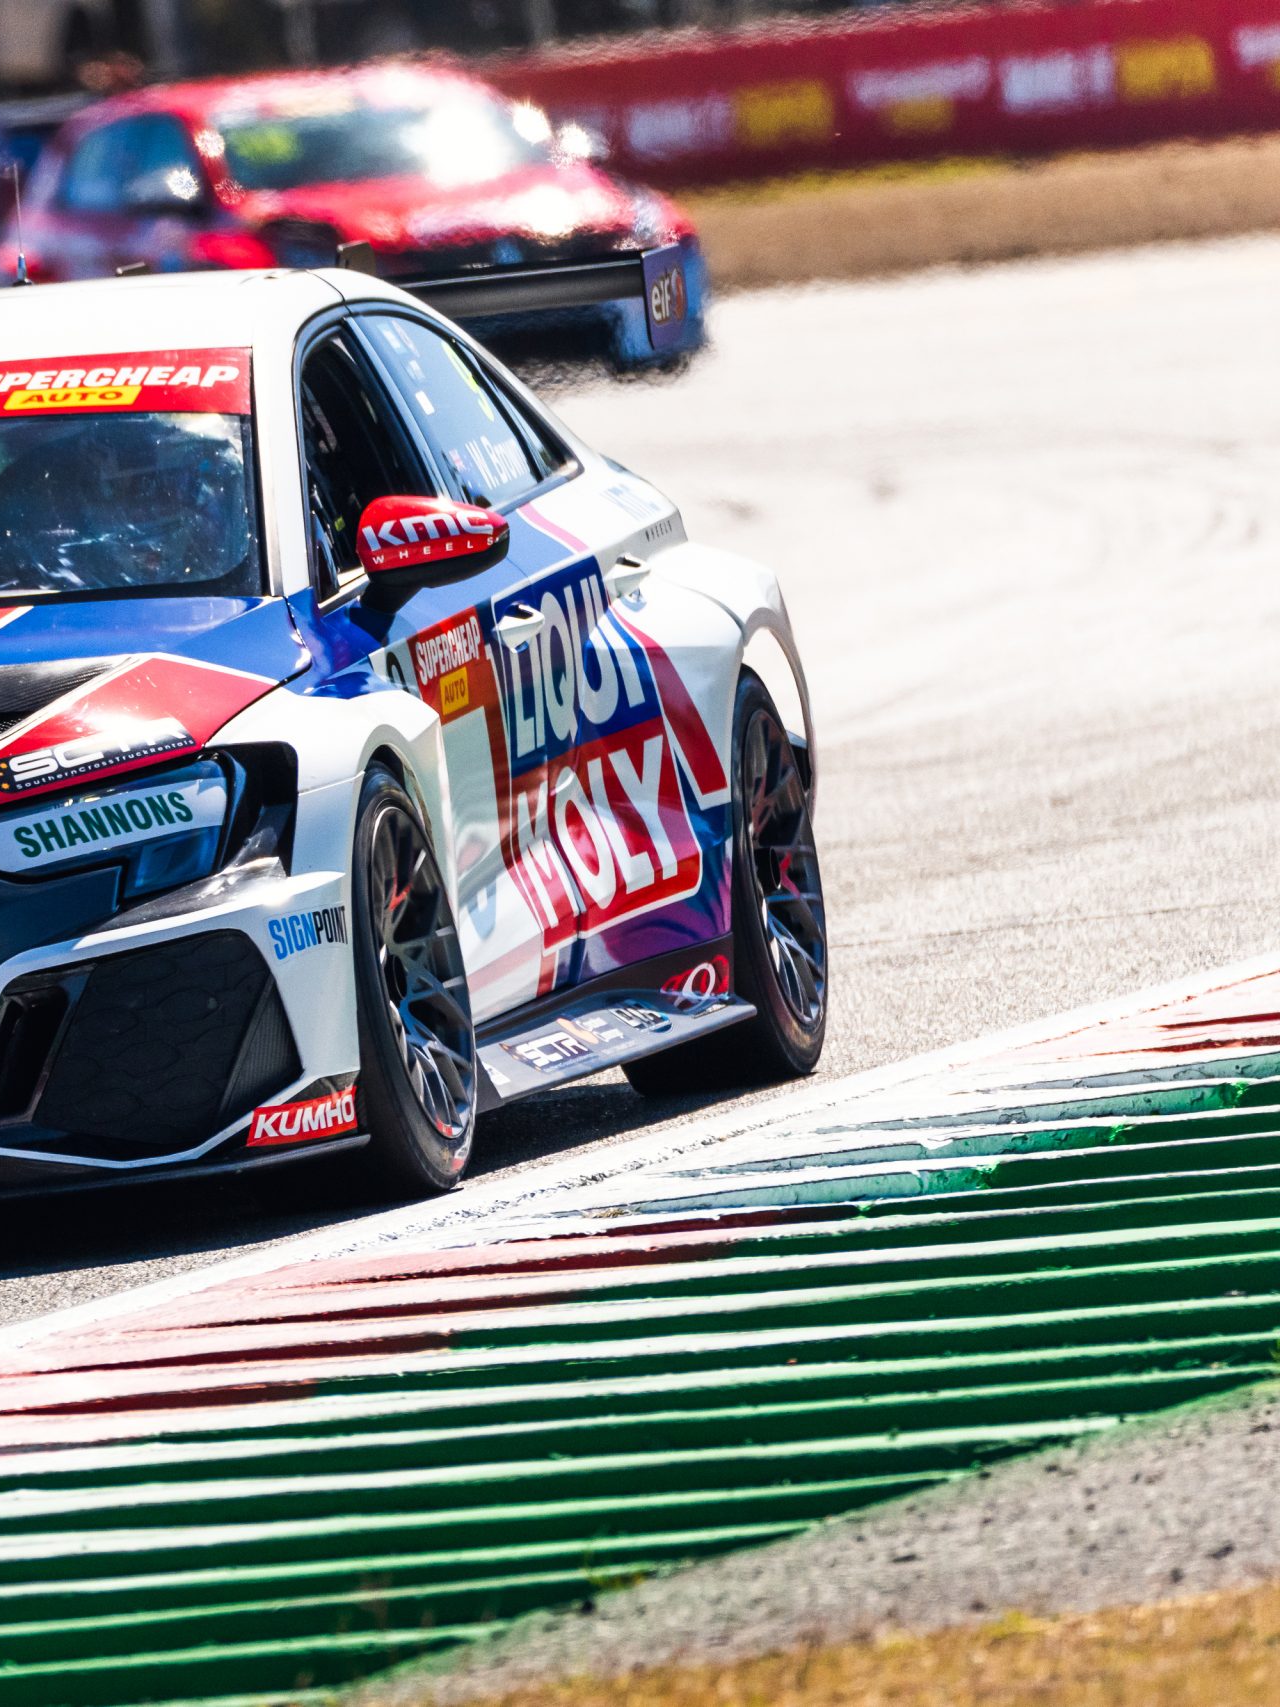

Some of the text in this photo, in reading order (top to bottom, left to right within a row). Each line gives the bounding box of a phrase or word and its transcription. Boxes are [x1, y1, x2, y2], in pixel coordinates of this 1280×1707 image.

[652, 278, 671, 321] elf
[22, 390, 123, 405] AUTO
[372, 537, 494, 565] WHEELS
[415, 616, 481, 687] SUPERCHEAP
[509, 573, 646, 759] LIQUI
[444, 678, 467, 705] AUTO
[14, 791, 193, 858] SHANNONS
[515, 734, 678, 928] MOLY
[254, 1096, 355, 1139] KUMHO
